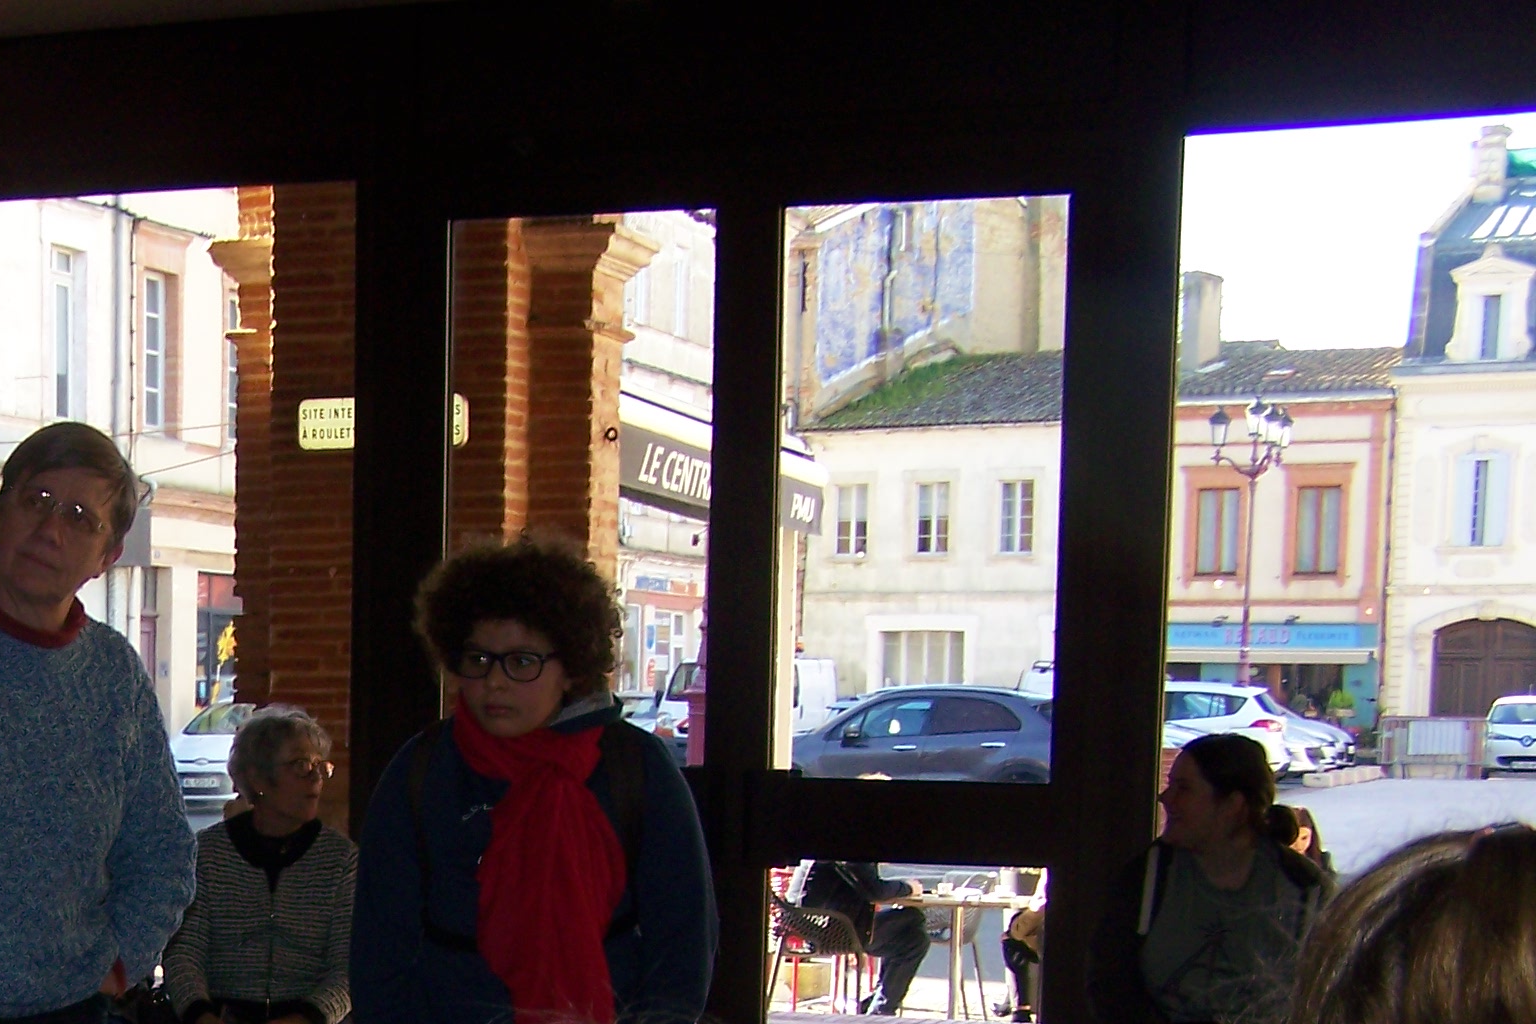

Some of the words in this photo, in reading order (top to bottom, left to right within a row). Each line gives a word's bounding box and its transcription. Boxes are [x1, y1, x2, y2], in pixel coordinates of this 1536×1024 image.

[302, 408, 325, 420] SITE
[328, 407, 352, 419] INTE
[312, 427, 354, 440] ROULET
[638, 442, 665, 486] LE
[661, 450, 711, 501] CENTR
[790, 493, 816, 524] PMU
